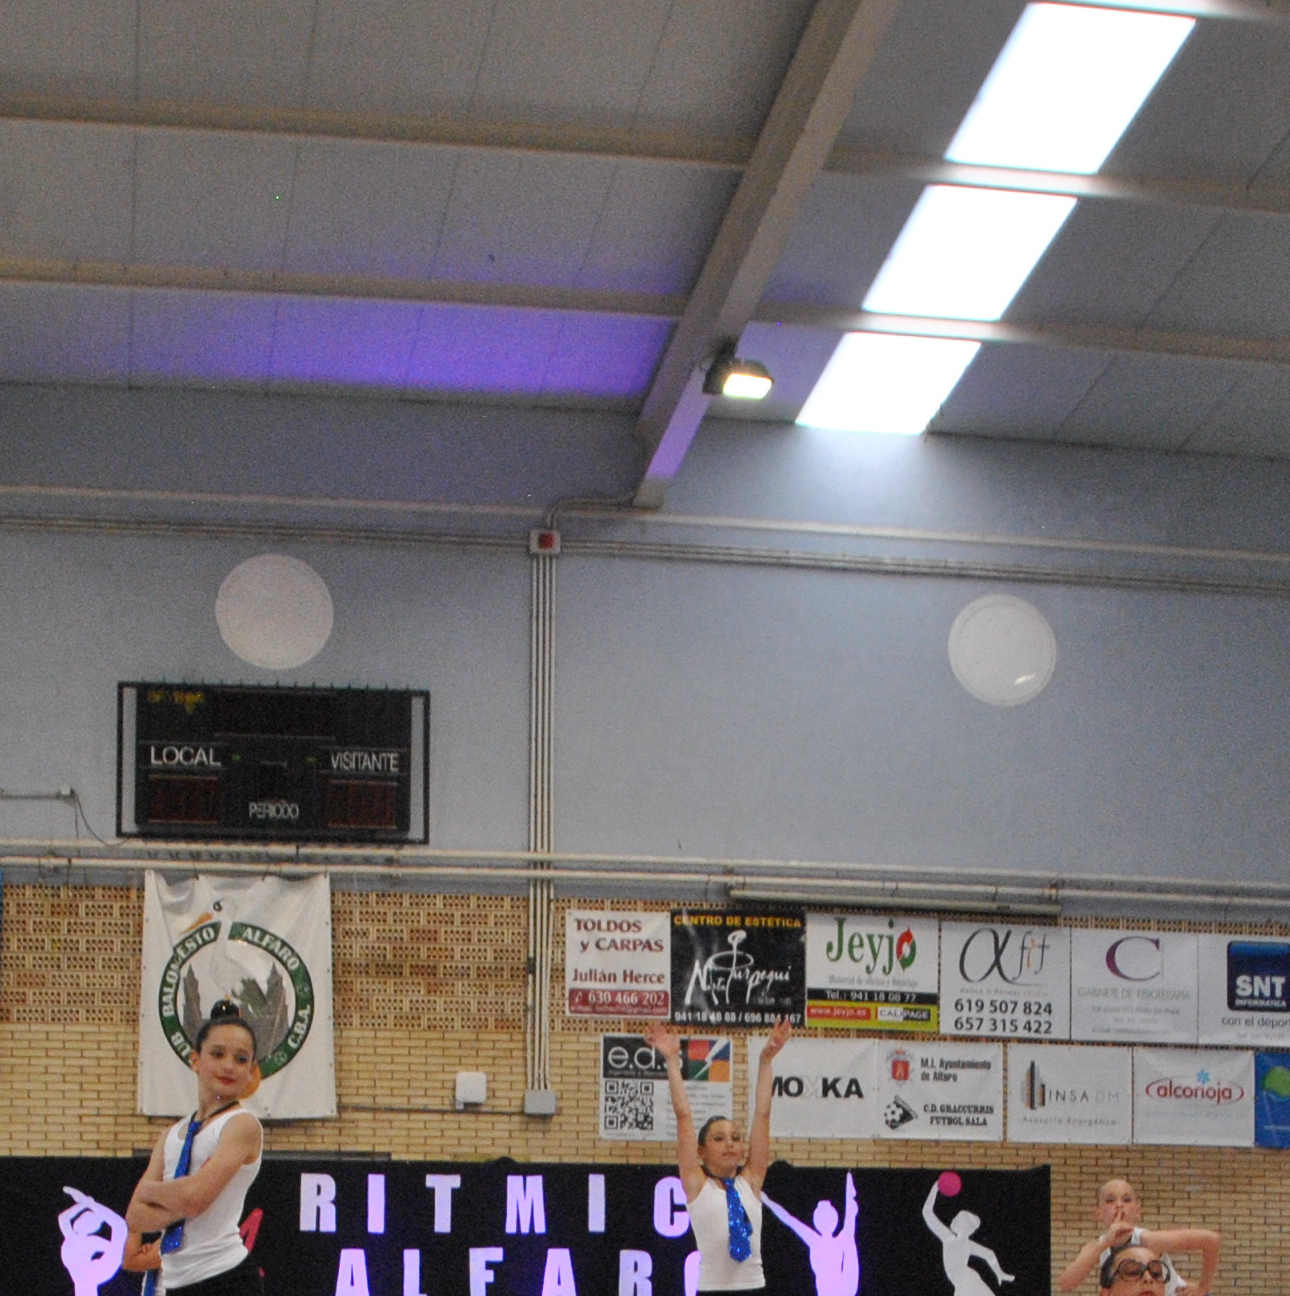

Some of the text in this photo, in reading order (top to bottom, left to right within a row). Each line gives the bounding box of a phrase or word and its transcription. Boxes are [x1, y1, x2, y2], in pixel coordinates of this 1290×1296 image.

[150, 745, 222, 767] LOCAL
[330, 751, 399, 772] VISITANTE
[249, 802, 299, 819] PERIODO
[574, 918, 643, 933] TOLDOS
[674, 914, 723, 926] CENTRO
[726, 915, 742, 926] DE
[242, 926, 301, 972] ALFARO
[580, 937, 664, 954] y CARPAS
[826, 916, 917, 975] Jeyjo
[572, 968, 666, 984] Julián Herce
[1235, 974, 1286, 998] SNT
[589, 990, 665, 1006] 630 466 202
[850, 991, 869, 1001] 941
[874, 991, 884, 1002] 18
[954, 998, 1053, 1016] 619 507 824
[954, 1016, 1053, 1035] 657 315 422
[1221, 1017, 1241, 1026] con
[1244, 1017, 1254, 1026] el
[1048, 1089, 1089, 1103] INSA
[965, 1117, 988, 1126] SALA
